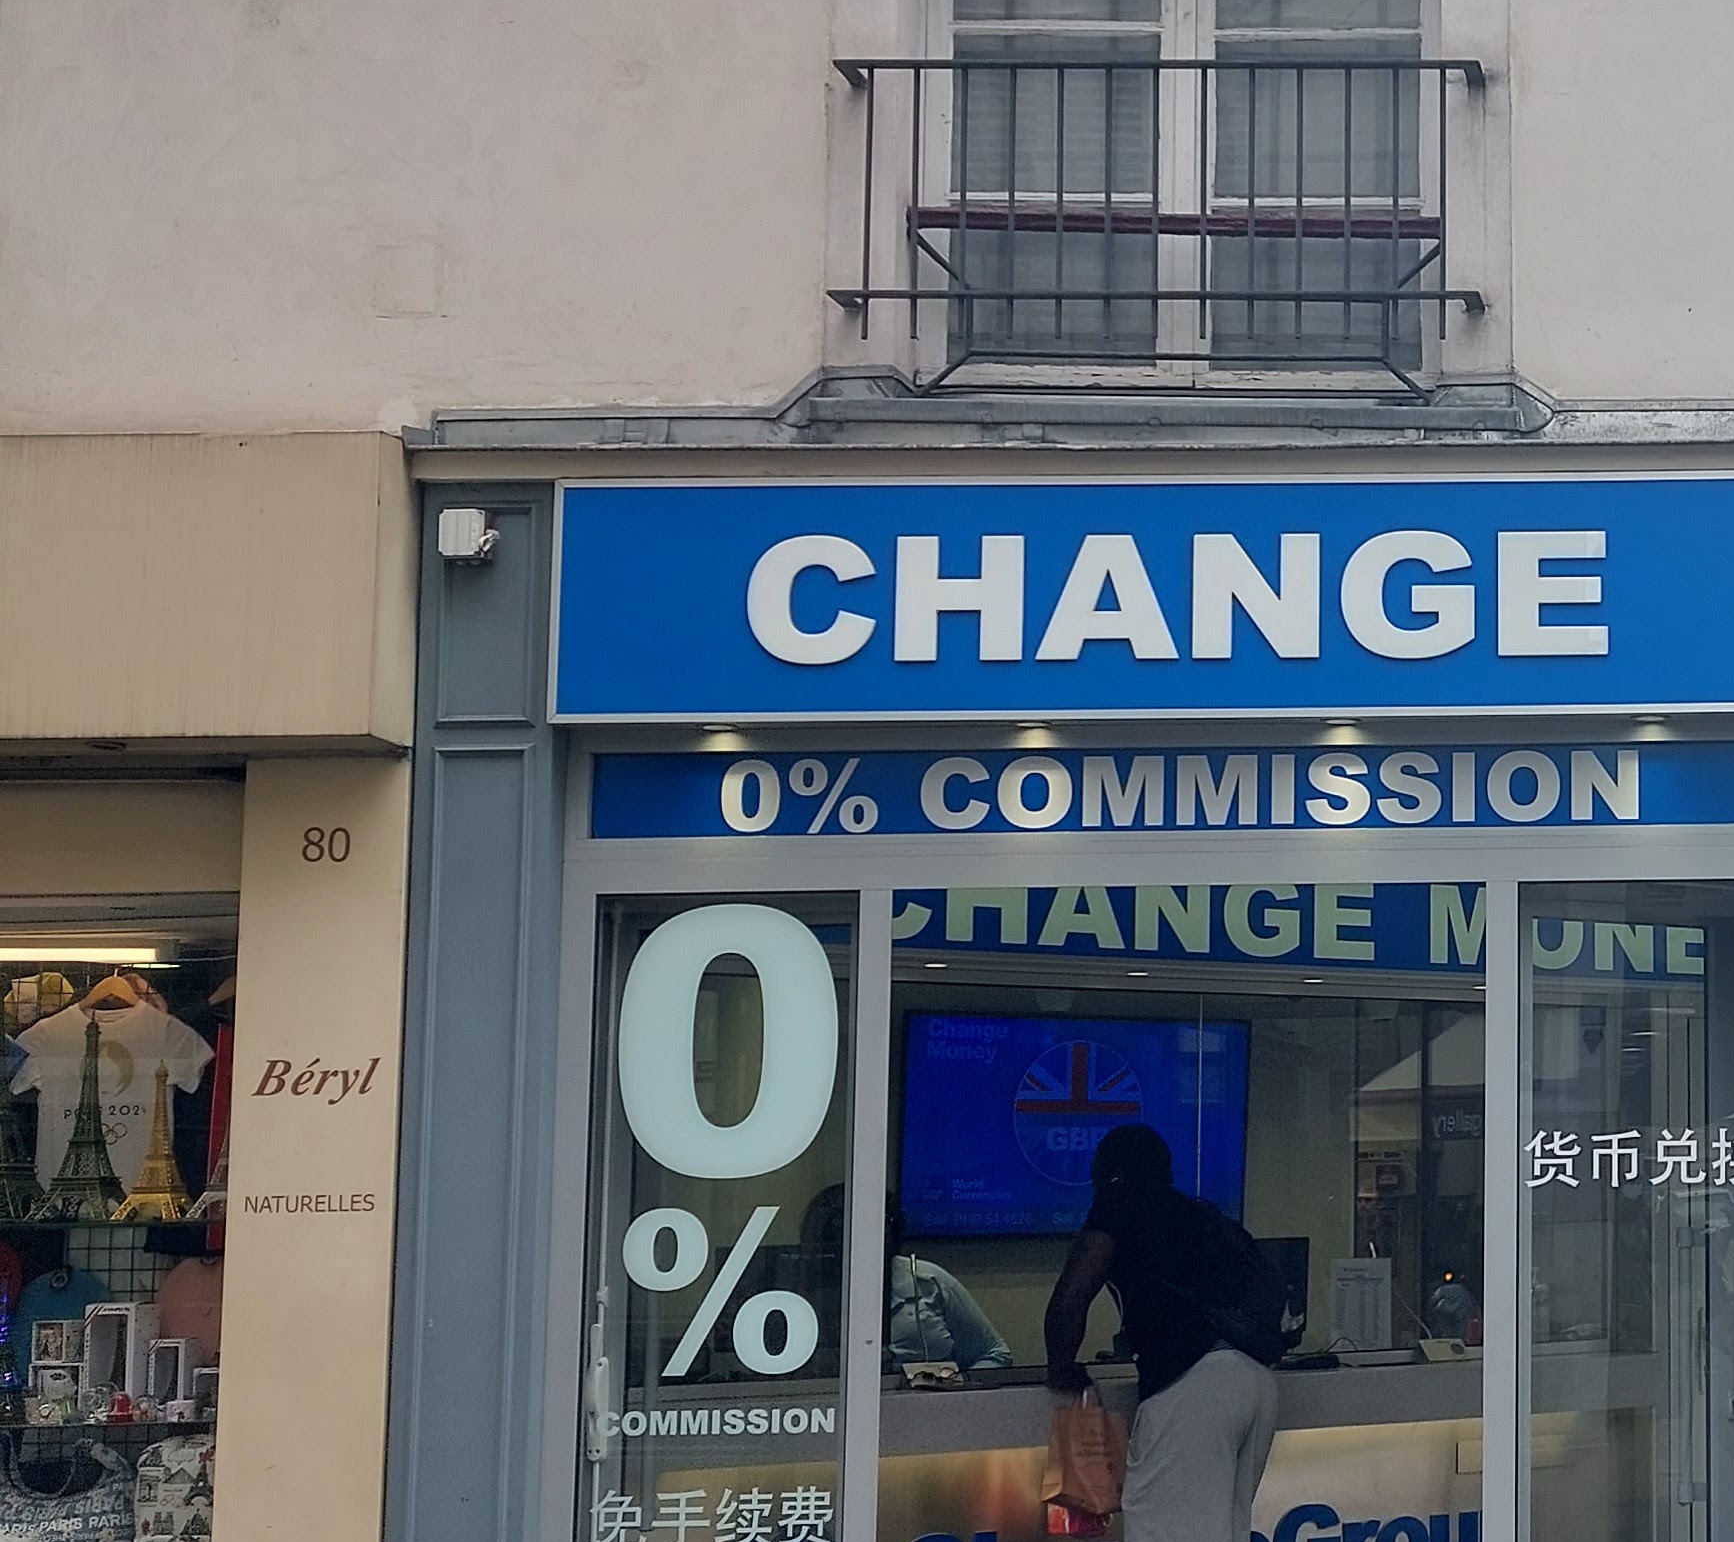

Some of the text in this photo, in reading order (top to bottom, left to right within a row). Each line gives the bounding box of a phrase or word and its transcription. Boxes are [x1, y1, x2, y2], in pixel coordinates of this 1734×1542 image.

[747, 529, 1609, 665] CHANGE
[720, 749, 1640, 834] 0% COMMISSION
[301, 827, 351, 863] 80
[618, 903, 839, 1179] 0
[928, 1019, 1009, 1043] Change
[927, 1040, 998, 1065] Money
[251, 1057, 381, 1106] Béryl
[109, 1105, 146, 1116] 202
[244, 1193, 376, 1214] NATURELLES
[622, 1205, 819, 1378] %
[600, 1408, 836, 1437] COMMISSION
[0, 1522, 35, 1535] ARIS
[39, 1517, 83, 1533] PARIS
